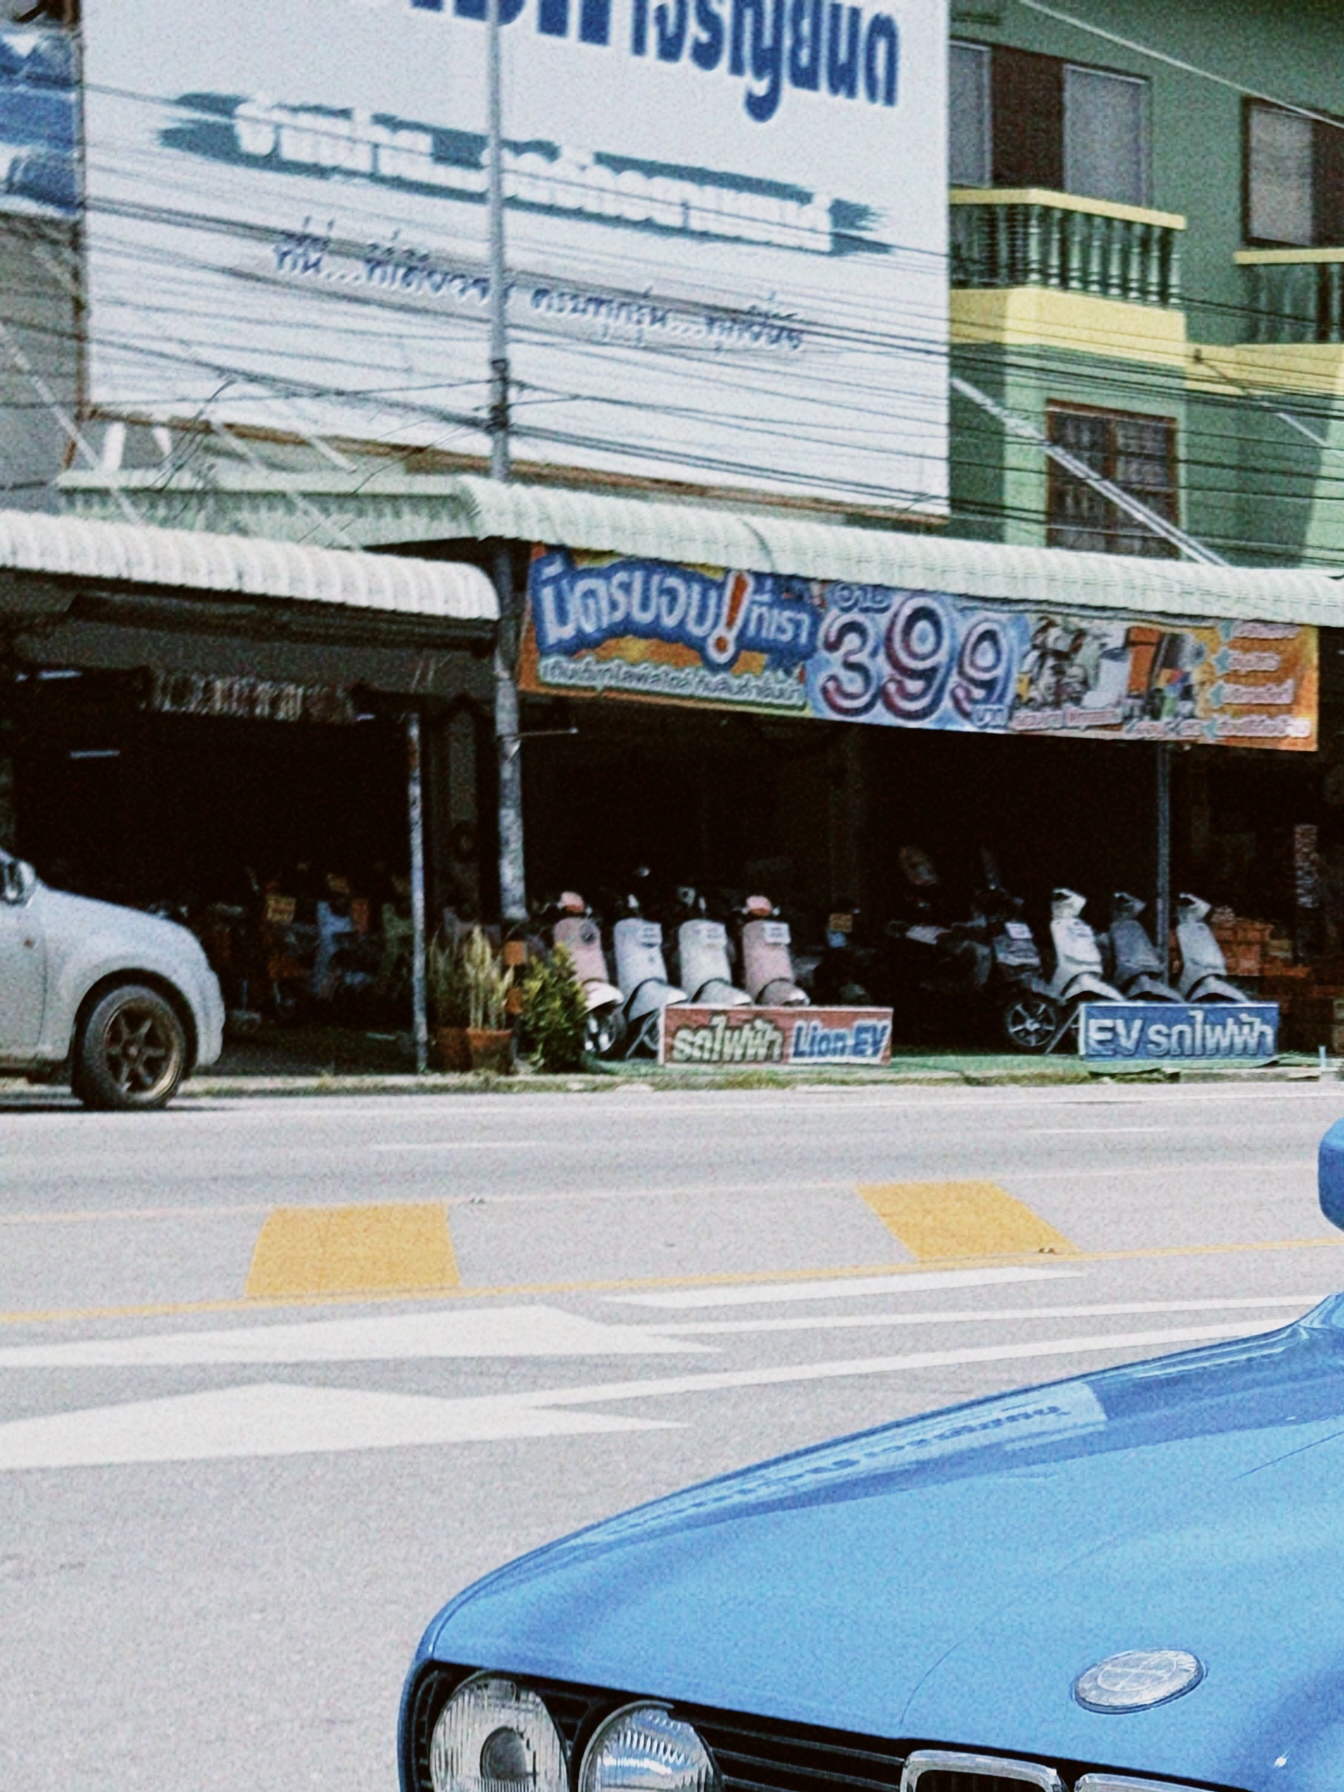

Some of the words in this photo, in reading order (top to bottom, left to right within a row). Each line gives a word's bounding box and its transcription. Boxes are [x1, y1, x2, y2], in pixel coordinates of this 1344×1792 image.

[819, 594, 1013, 723] 399
[672, 1014, 785, 1063] รถไฟฟ้า
[852, 1021, 890, 1058] EV
[1088, 1019, 1143, 1056] EV
[1147, 1009, 1276, 1057] รถไฟฟ้า
